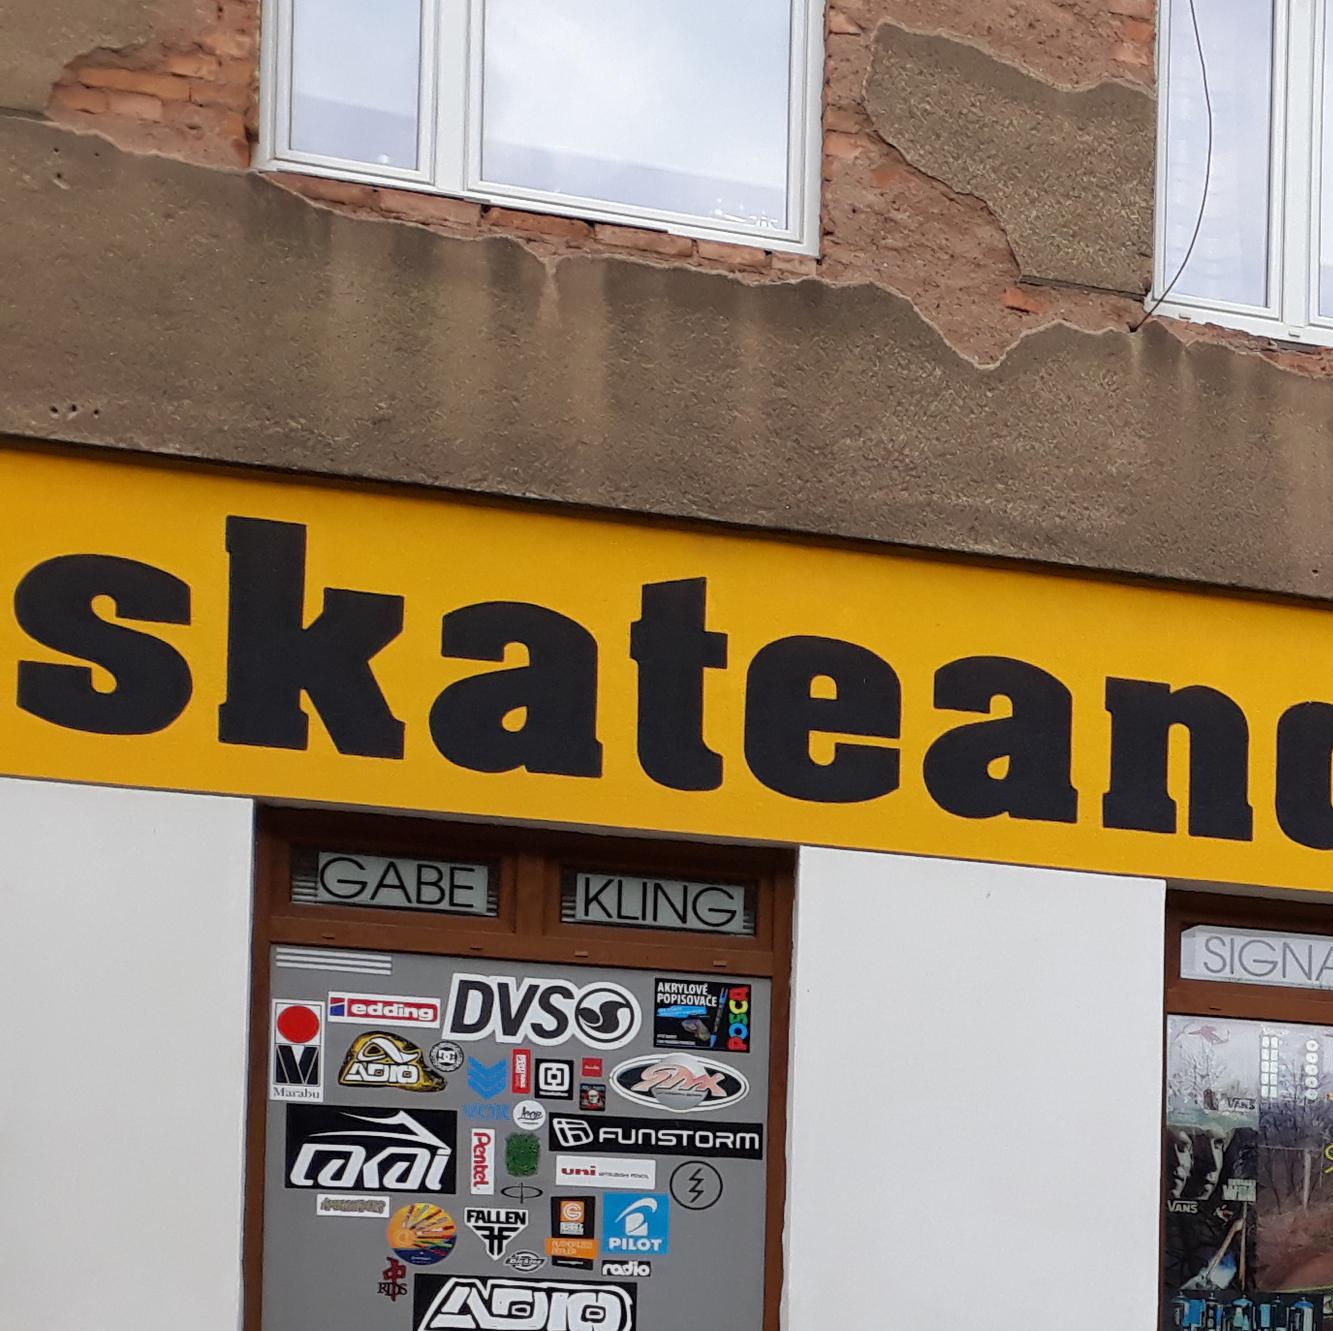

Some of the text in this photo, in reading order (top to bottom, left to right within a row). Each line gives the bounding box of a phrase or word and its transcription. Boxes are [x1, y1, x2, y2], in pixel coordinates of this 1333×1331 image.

[319, 855, 739, 928] GABE KLING
[657, 981, 709, 995] AKRYLOVÉ
[656, 993, 718, 1007] POPISOVAČE
[350, 1002, 436, 1021] edding
[450, 979, 575, 1040] DVS
[728, 986, 749, 1051] POSCA
[343, 1062, 420, 1084] ADIO
[272, 1086, 320, 1100] Marabu
[599, 1127, 760, 1150] FUNSTORM
[472, 1132, 491, 1187] Pentel
[561, 1165, 596, 1177] uni
[1167, 1199, 1199, 1214] VANS
[466, 1209, 526, 1225] FALLEN
[608, 1237, 662, 1251] PILOT
[602, 1260, 651, 1277] radio
